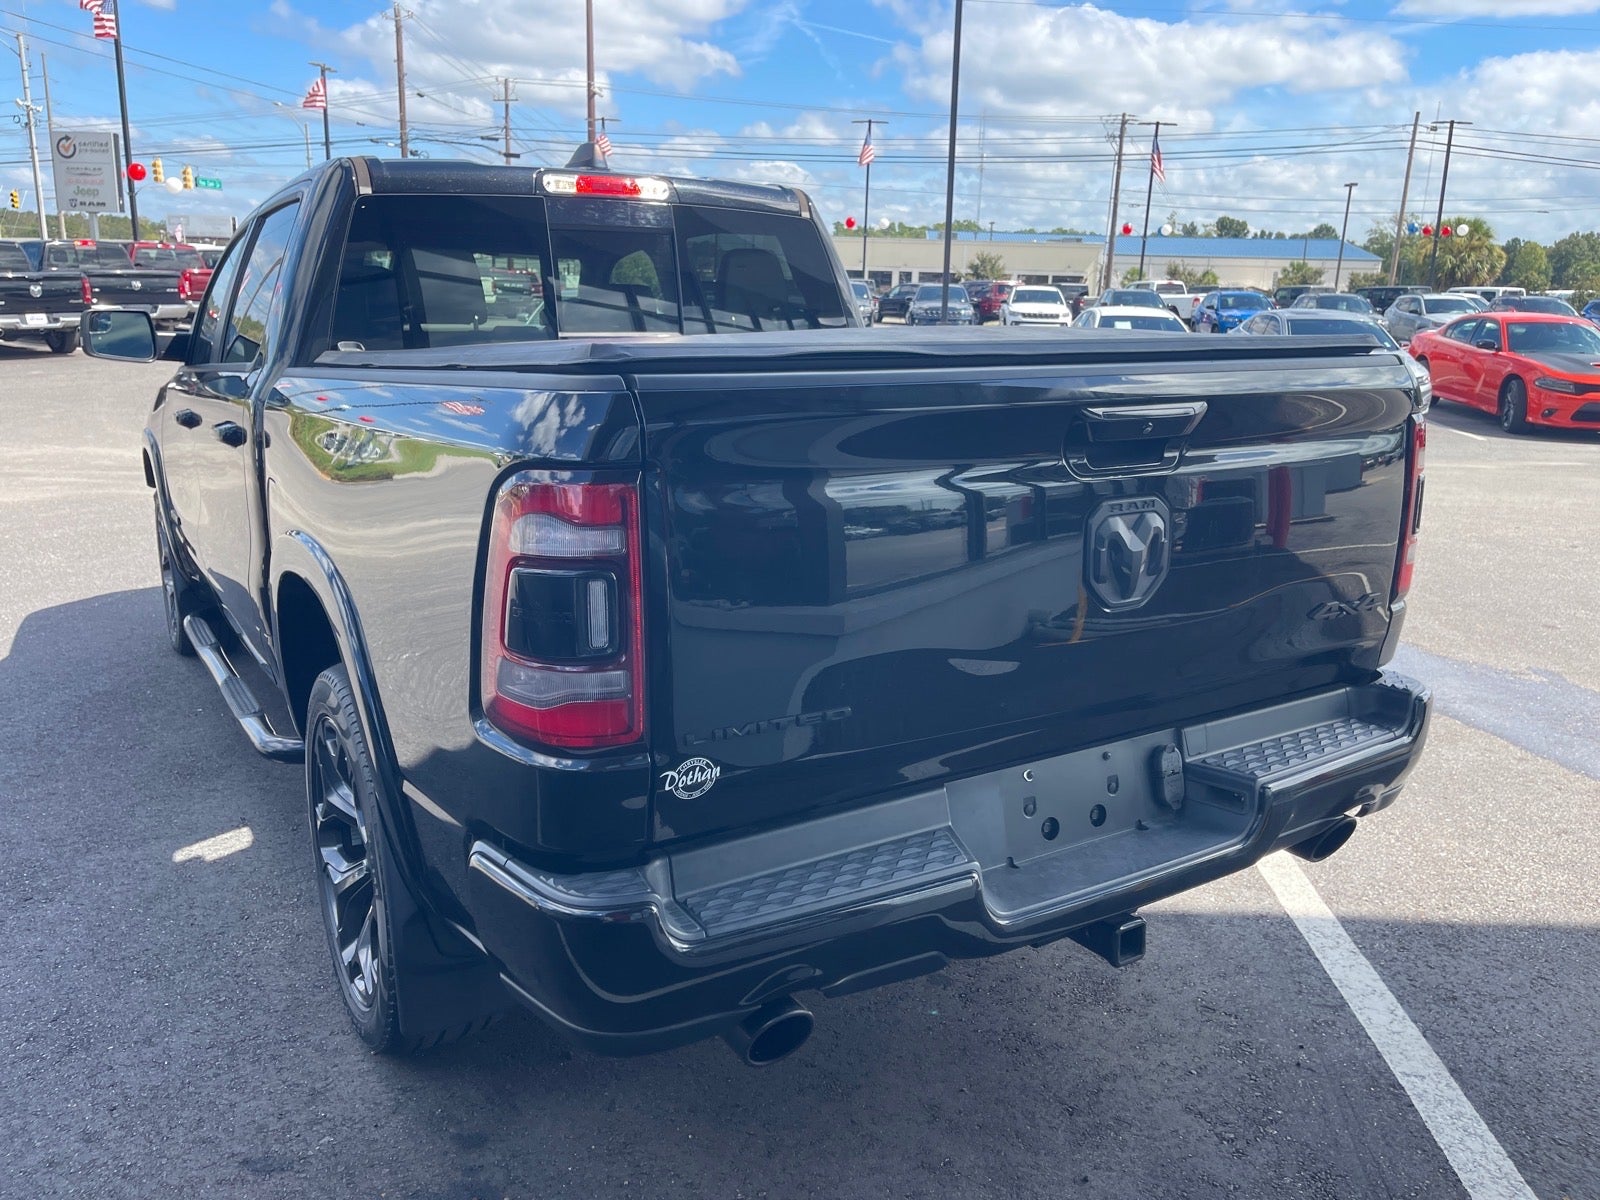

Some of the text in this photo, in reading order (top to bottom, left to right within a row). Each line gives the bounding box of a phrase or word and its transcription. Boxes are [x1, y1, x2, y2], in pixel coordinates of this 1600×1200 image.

[73, 185, 100, 199] Jeep
[1110, 500, 1156, 513] RAM
[684, 706, 852, 747] LIMITED
[679, 759, 707, 772] CHRYSLER
[659, 766, 721, 791] Dothan
